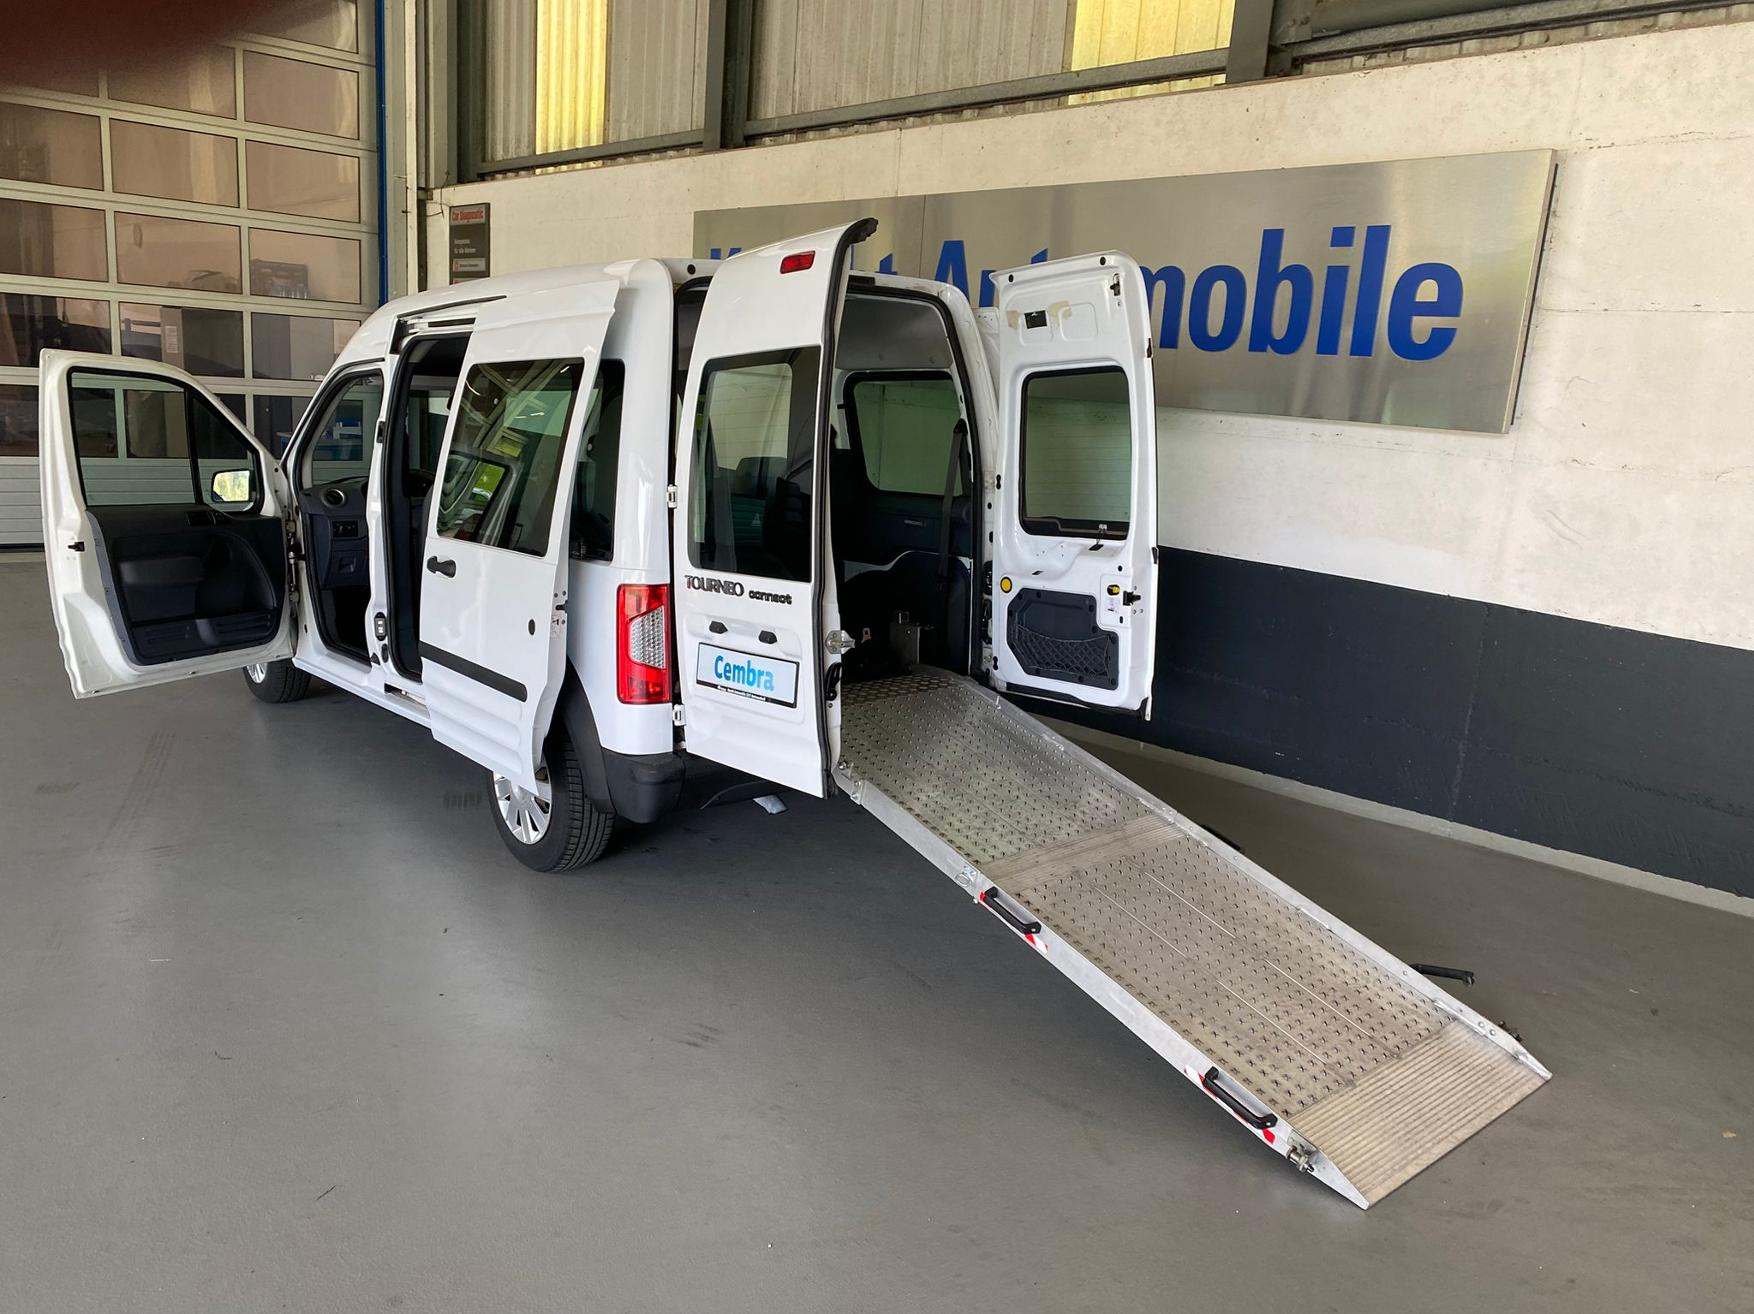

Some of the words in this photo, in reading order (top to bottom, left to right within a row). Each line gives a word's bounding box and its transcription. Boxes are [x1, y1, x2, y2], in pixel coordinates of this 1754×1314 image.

[684, 575, 744, 597] TOURNEO
[748, 590, 792, 605] connect
[714, 655, 775, 692] Cembra
